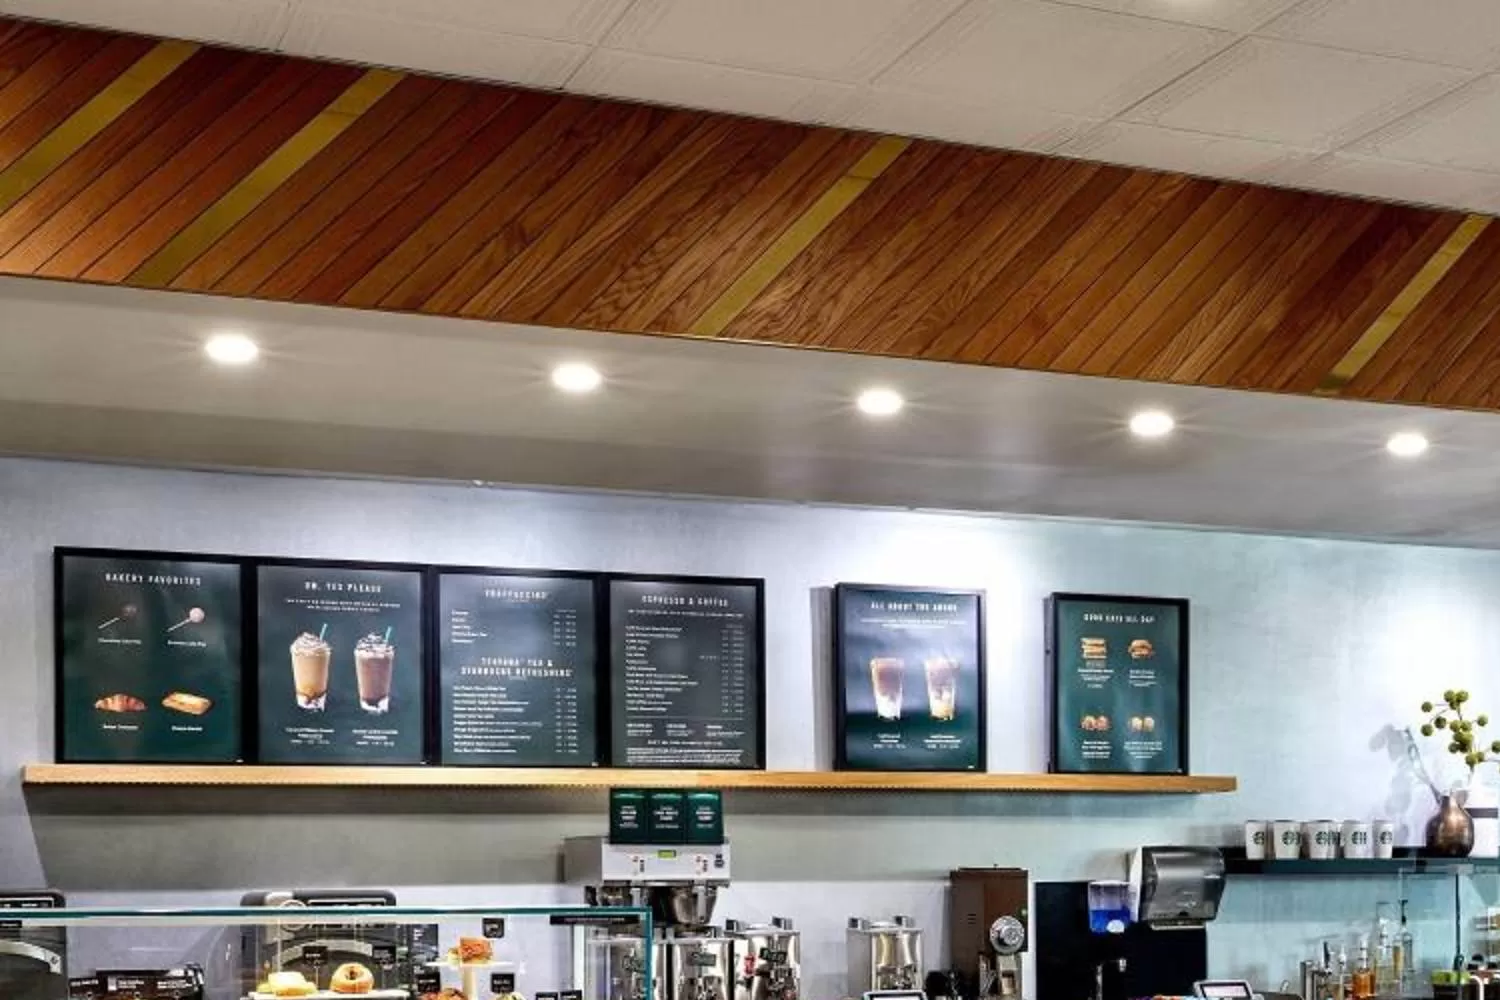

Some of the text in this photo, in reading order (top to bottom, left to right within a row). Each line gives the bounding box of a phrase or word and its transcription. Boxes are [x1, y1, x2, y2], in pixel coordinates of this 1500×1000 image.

[105, 573, 201, 586] BAKERY FAVORITES
[642, 595, 685, 606] ESPRESSO
